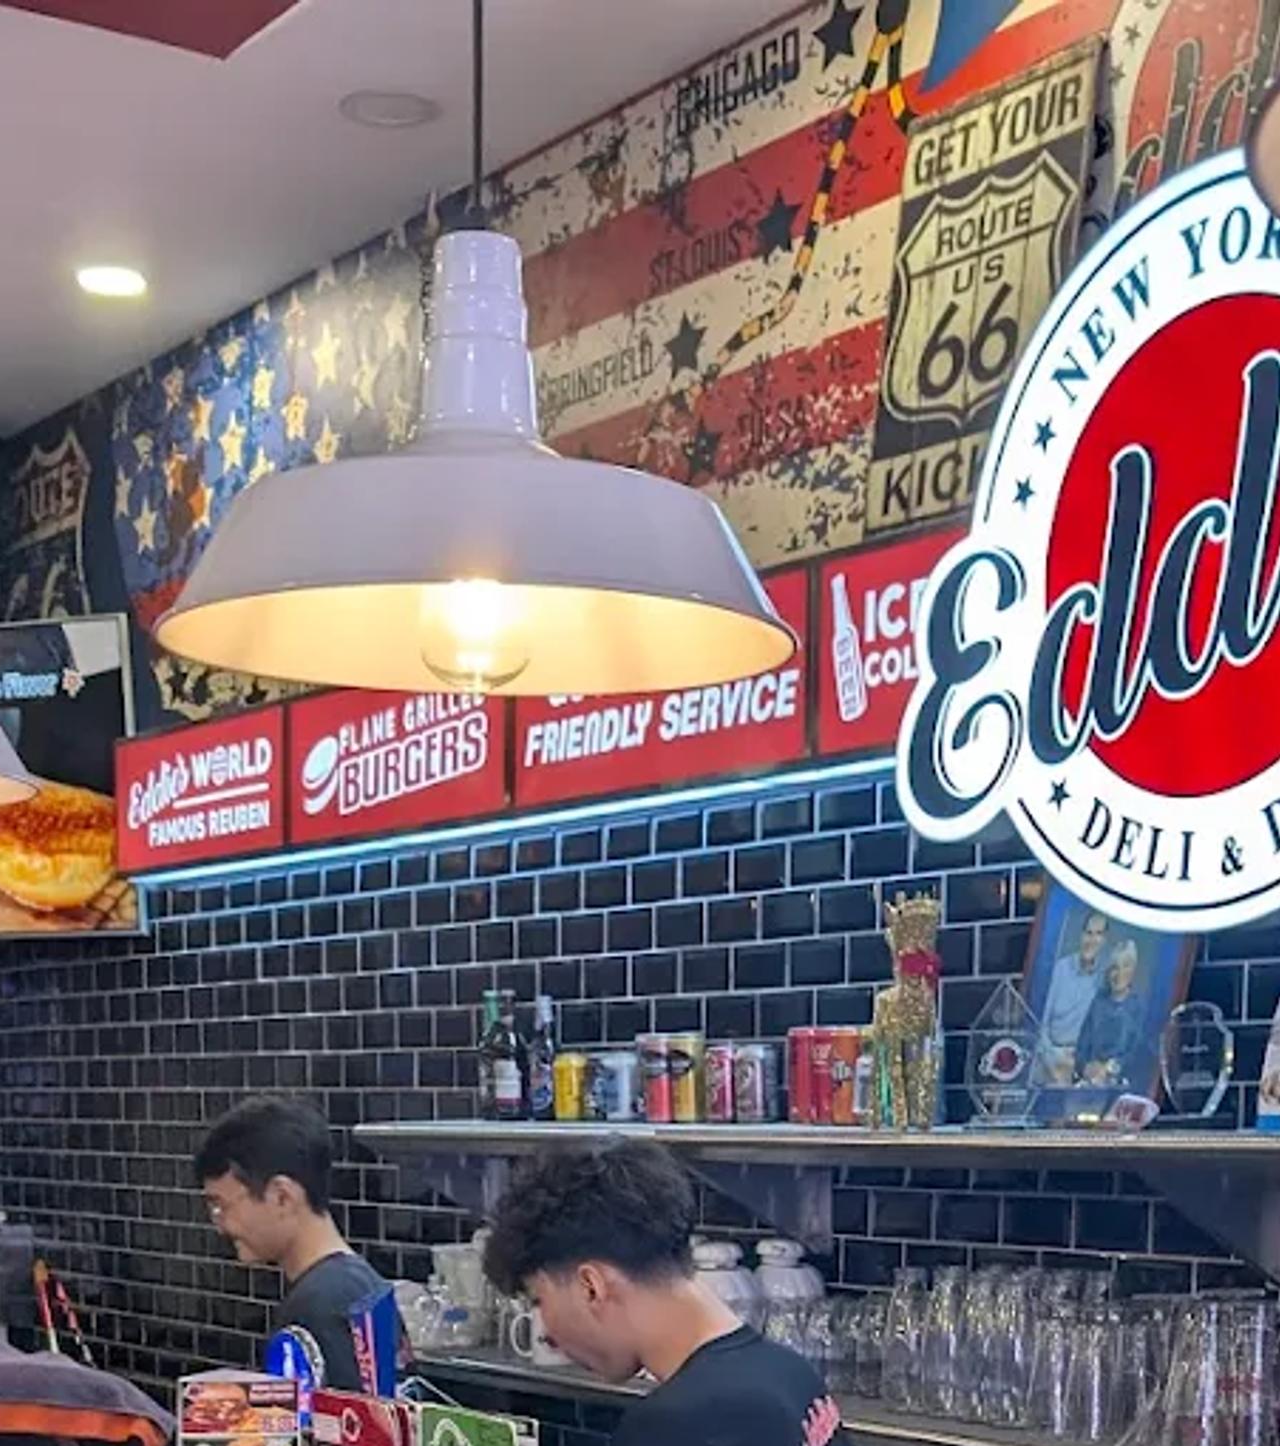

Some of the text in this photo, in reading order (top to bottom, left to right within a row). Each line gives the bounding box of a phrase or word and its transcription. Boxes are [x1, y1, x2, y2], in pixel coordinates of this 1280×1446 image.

[676, 28, 801, 138] CHICAGO
[913, 75, 1083, 188] GET YOUR
[936, 197, 1034, 260] ROUTE
[919, 282, 1020, 400] 66
[1051, 257, 1153, 400] NEW
[523, 668, 802, 768] FRIENDLY SERVICE
[863, 646, 919, 690] COL
[191, 737, 273, 790] WORLD
[339, 712, 489, 816] BURGERS
[148, 800, 271, 849] FAMOUS REUBEN
[1079, 805, 1194, 882] DELI
[1219, 834, 1246, 877] &
